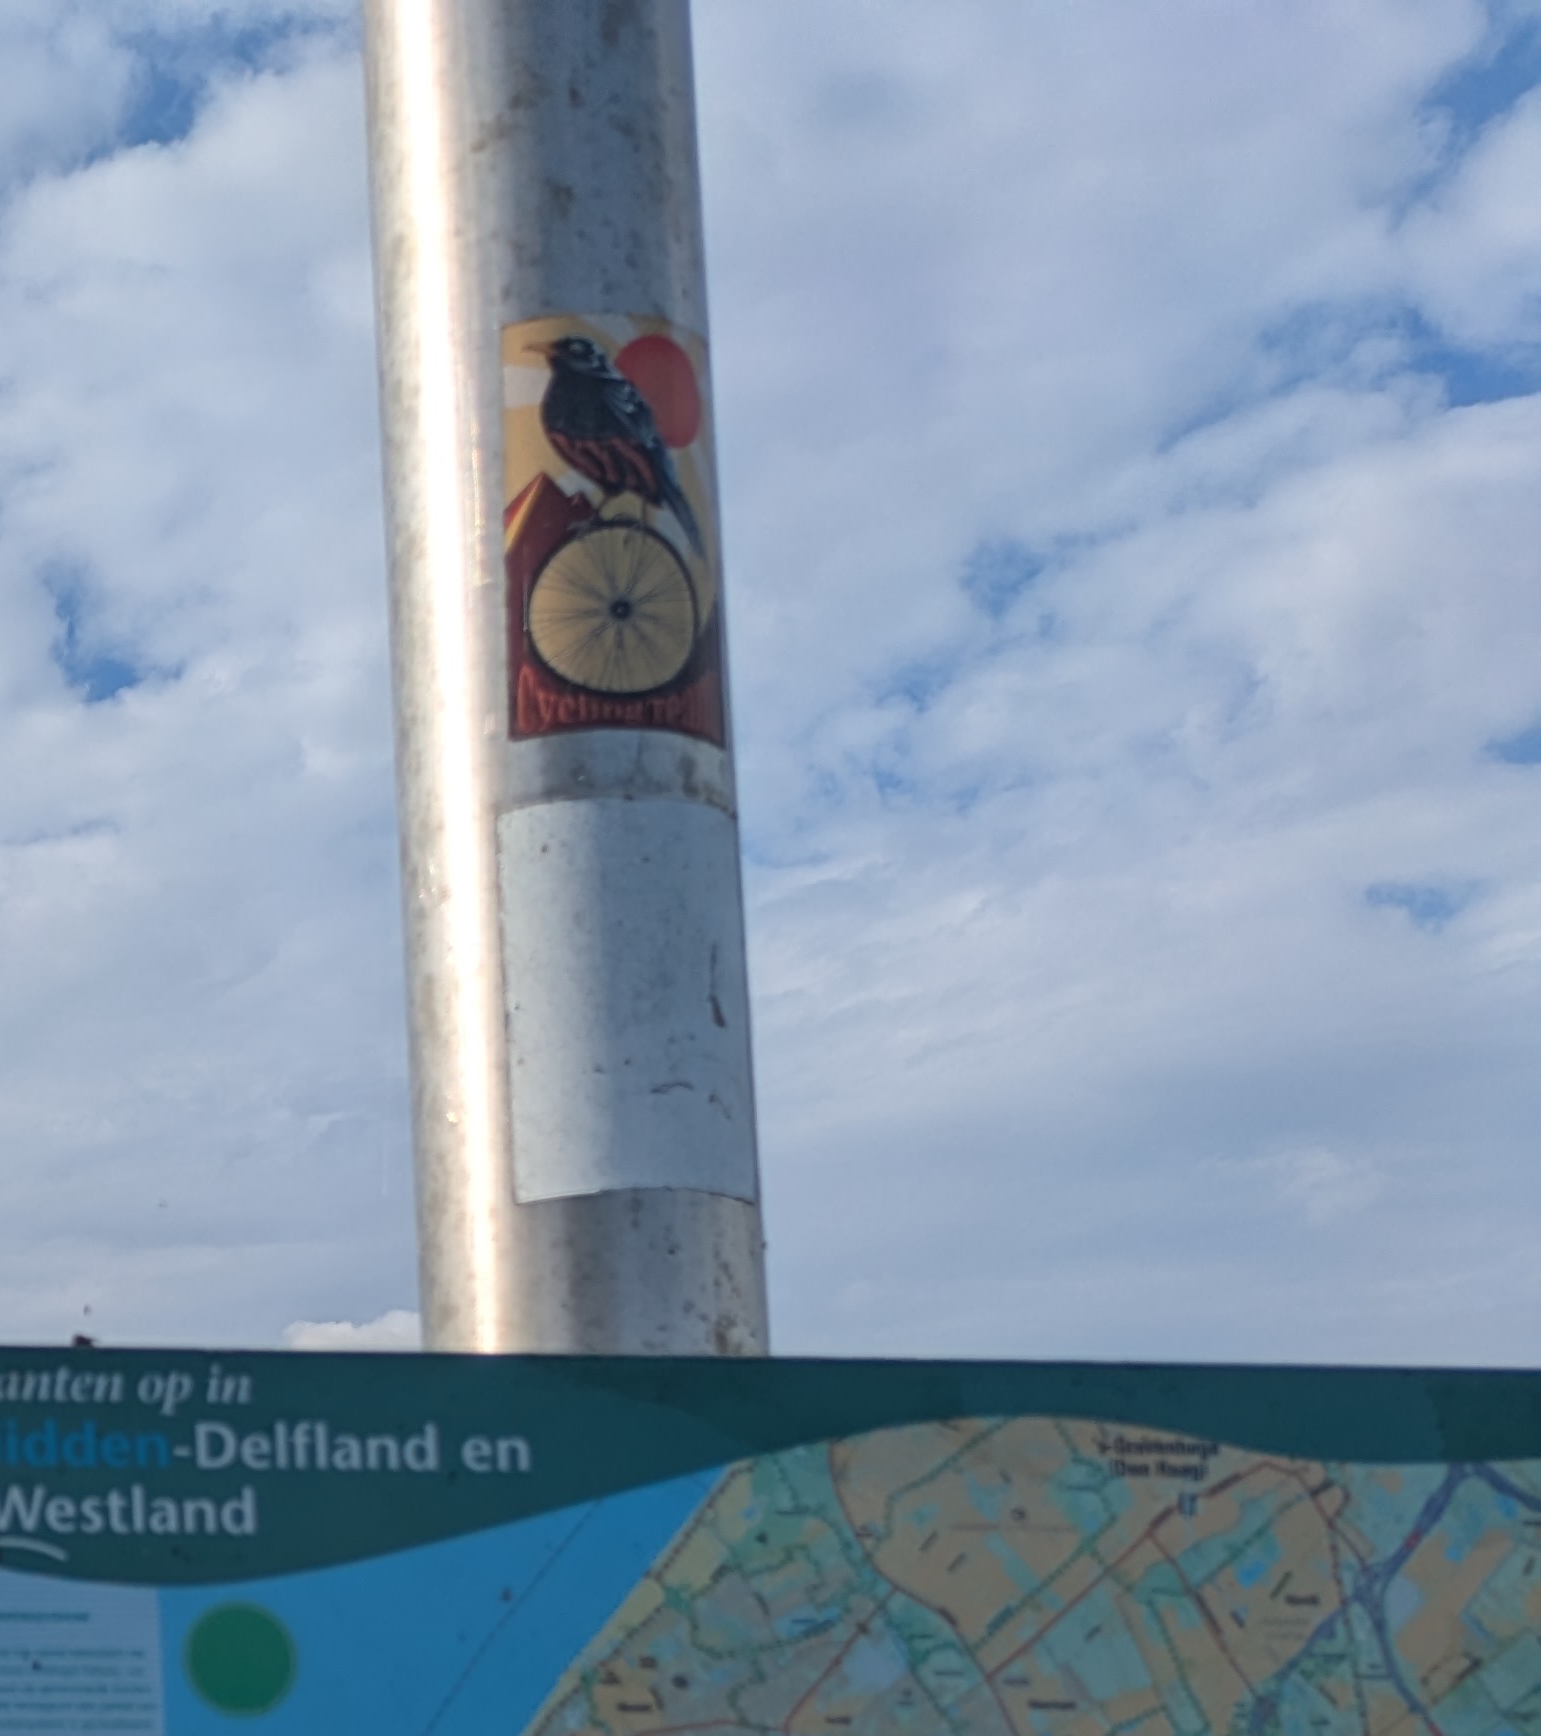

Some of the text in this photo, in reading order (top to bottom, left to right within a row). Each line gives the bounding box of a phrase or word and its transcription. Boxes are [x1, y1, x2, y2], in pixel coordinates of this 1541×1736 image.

[136, 1369, 194, 1416] op
[205, 1363, 253, 1405] in
[460, 1433, 533, 1473] en
